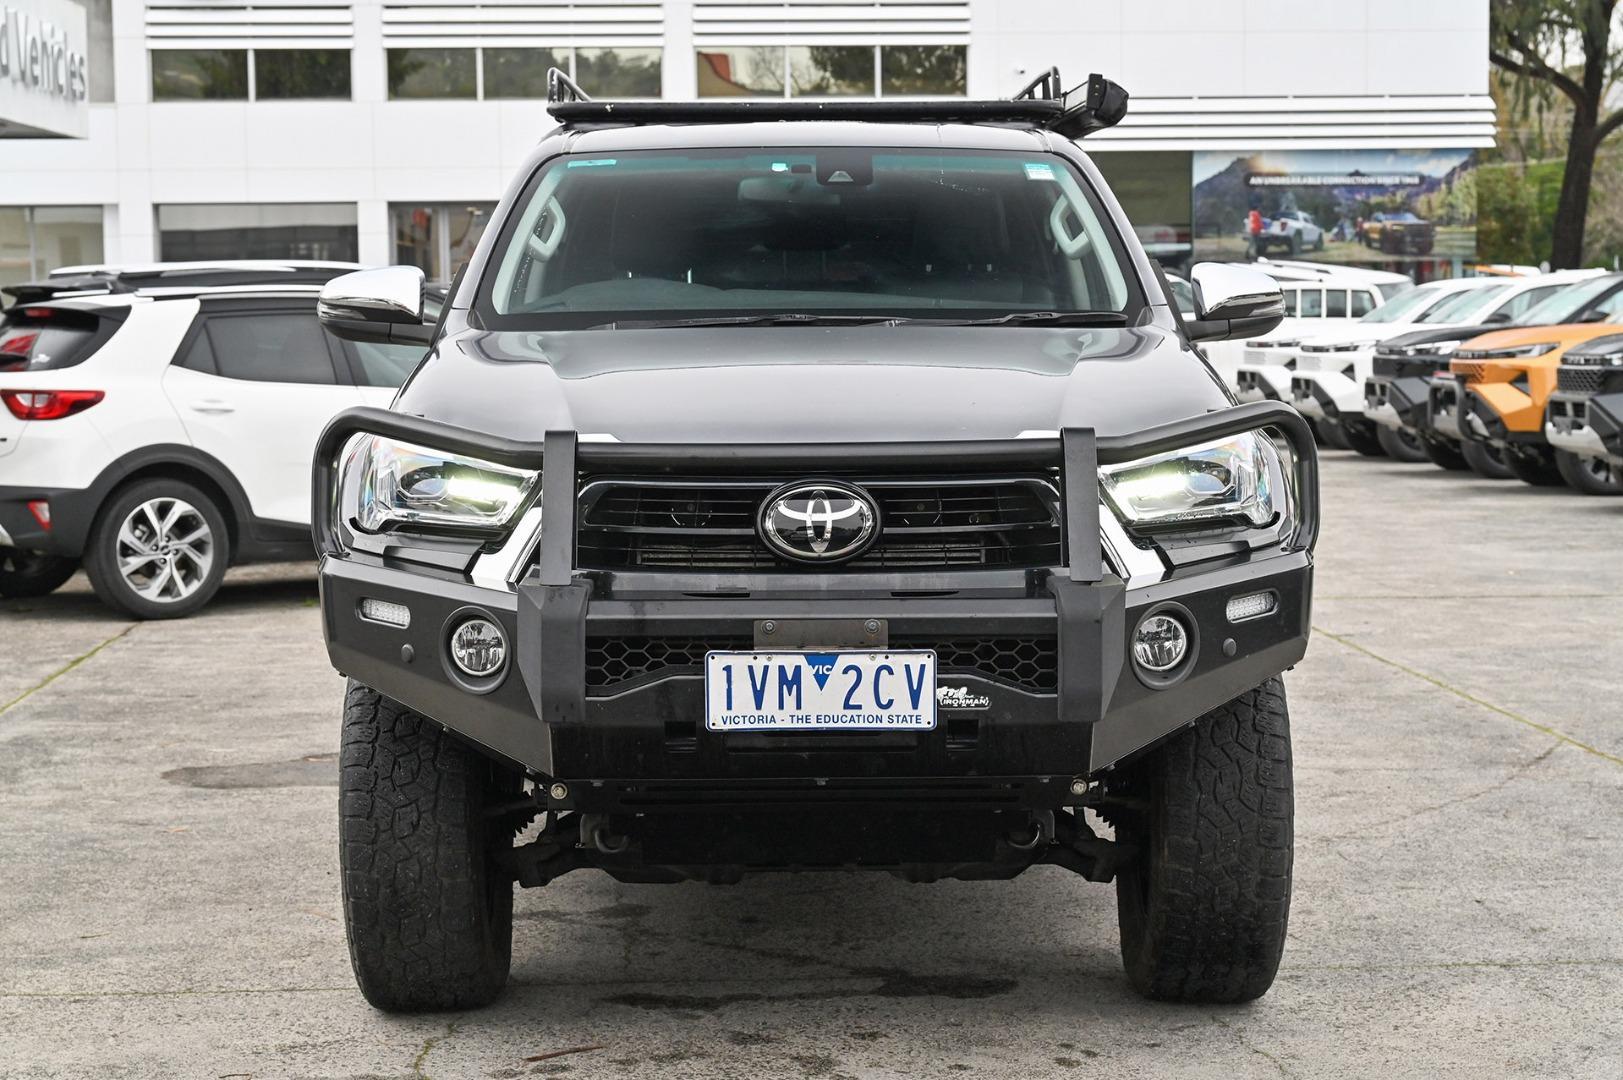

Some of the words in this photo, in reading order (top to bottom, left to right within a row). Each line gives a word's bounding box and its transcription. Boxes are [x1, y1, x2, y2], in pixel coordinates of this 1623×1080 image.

[15, 10, 85, 102] Vehicles
[809, 664, 833, 675] VIC
[722, 664, 802, 711] 1VM
[841, 663, 927, 711] 2CV
[942, 698, 987, 706] IRONMAN
[721, 715, 776, 725] VICTORIA
[789, 714, 812, 724] THE
[816, 714, 882, 724] EDUCATION
[887, 714, 922, 724] STATE
